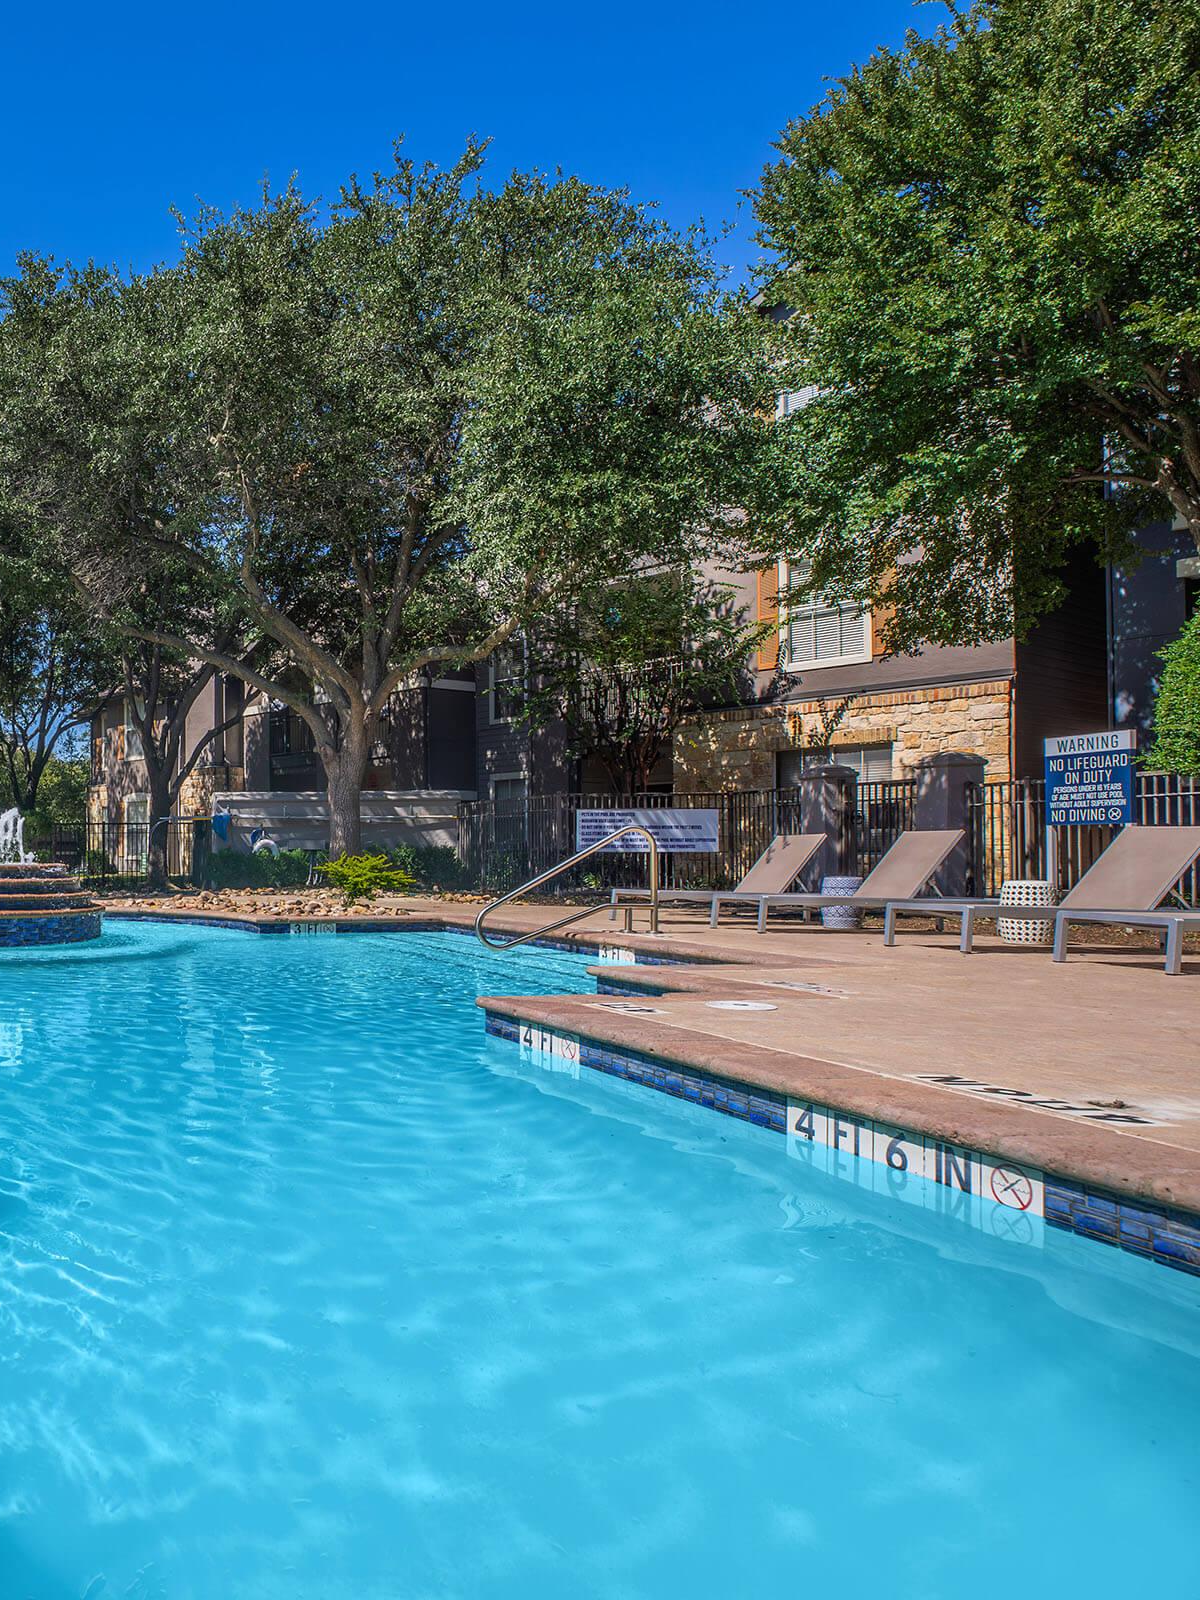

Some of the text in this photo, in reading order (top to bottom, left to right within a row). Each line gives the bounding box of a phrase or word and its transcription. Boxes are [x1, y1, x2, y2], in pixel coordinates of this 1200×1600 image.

[1057, 734, 1119, 753] WARNING
[1050, 754, 1128, 772] NO LIFEGUARD
[1065, 769, 1113, 785] ON DUTY
[1053, 785, 1078, 794] PERSONS
[1078, 784, 1096, 792] UNDER
[1103, 782, 1122, 790] YEARS
[1059, 793, 1070, 801] AGE
[1070, 792, 1086, 800] MUST
[1086, 791, 1097, 799] NOT
[1098, 791, 1108, 799] USE
[1109, 790, 1124, 798] POOL
[1049, 798, 1127, 809] WITHOUT ADULT SUPERVISION
[1051, 808, 1106, 822] NO DIVING
[294, 923, 318, 935] 3 FT
[602, 945, 608, 958] 3
[523, 1023, 555, 1053] 4 FT
[794, 1103, 972, 1195] 4 FT 6 IN
